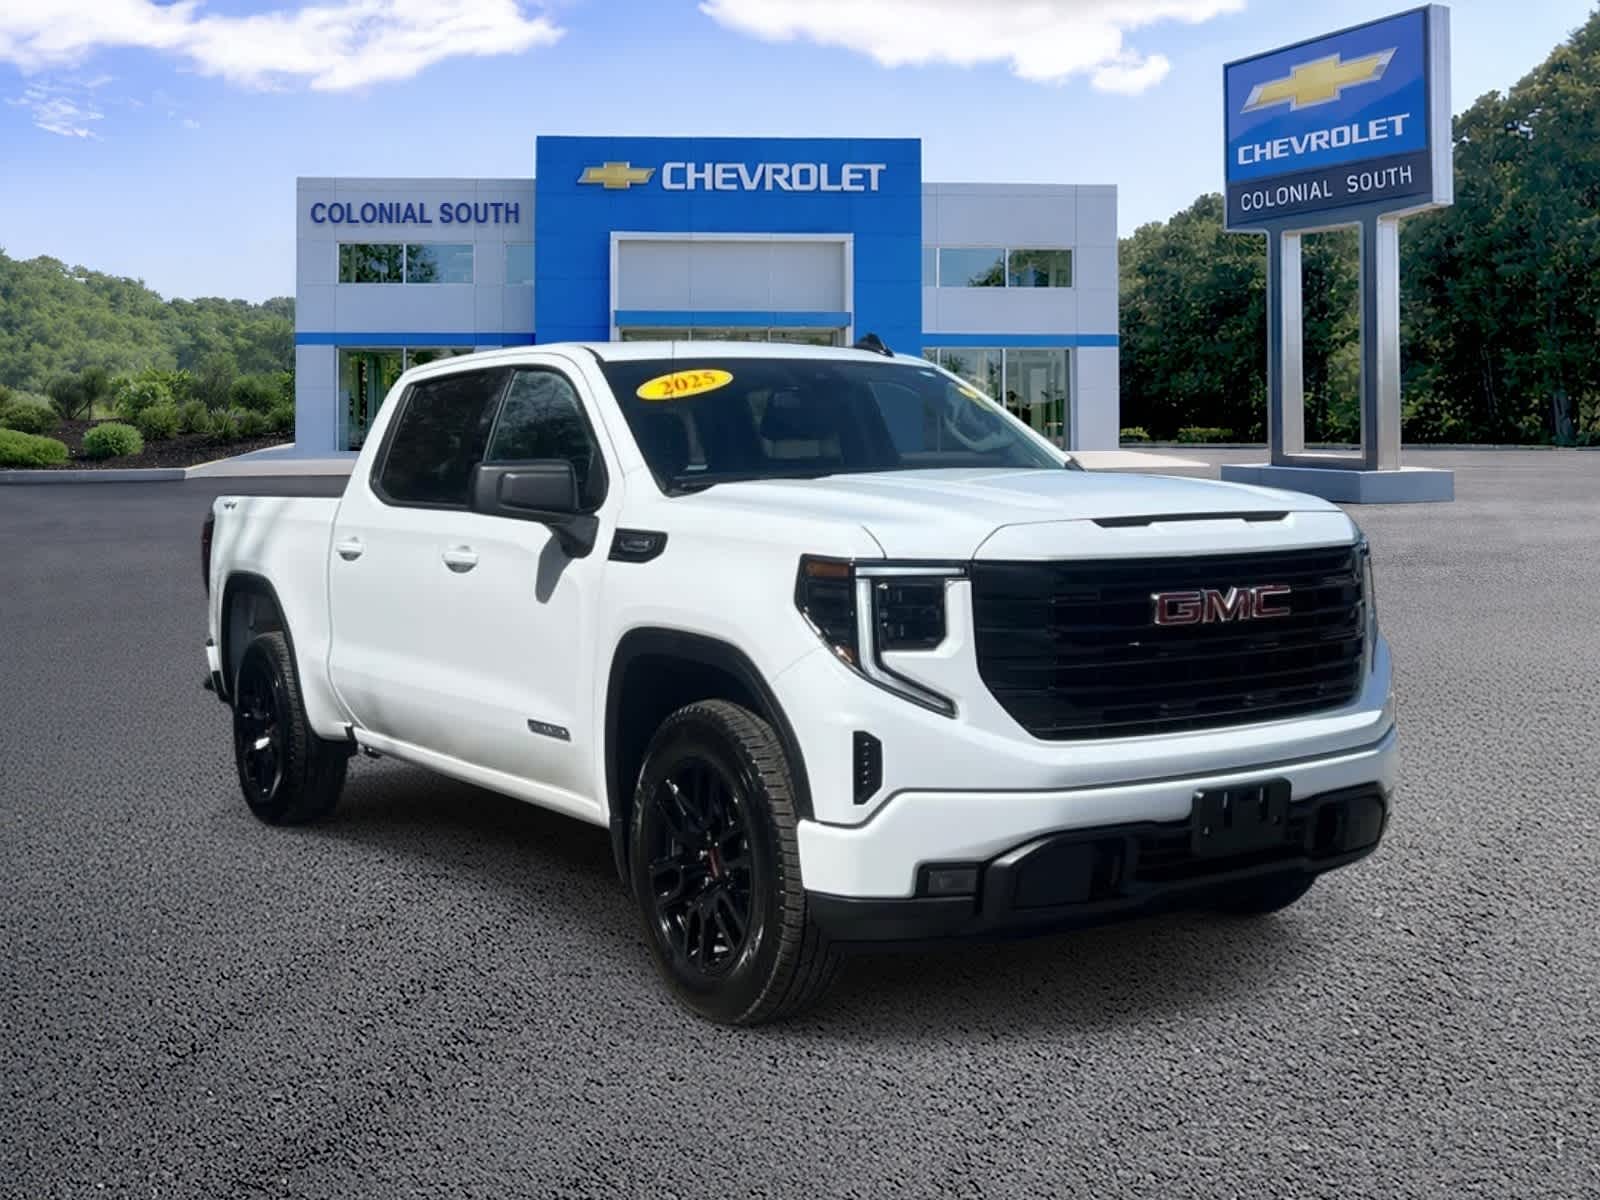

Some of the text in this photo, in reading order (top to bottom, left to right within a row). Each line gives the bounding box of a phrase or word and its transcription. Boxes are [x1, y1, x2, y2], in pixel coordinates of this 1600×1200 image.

[1237, 113, 1410, 165] CHEVROLET
[661, 161, 887, 192] CHEVROLET
[1241, 165, 1412, 211] COLONIAL SOUTH
[310, 202, 520, 225] COLONIAL SOUTH
[661, 372, 716, 395] 2025
[1150, 584, 1291, 625] GMC
